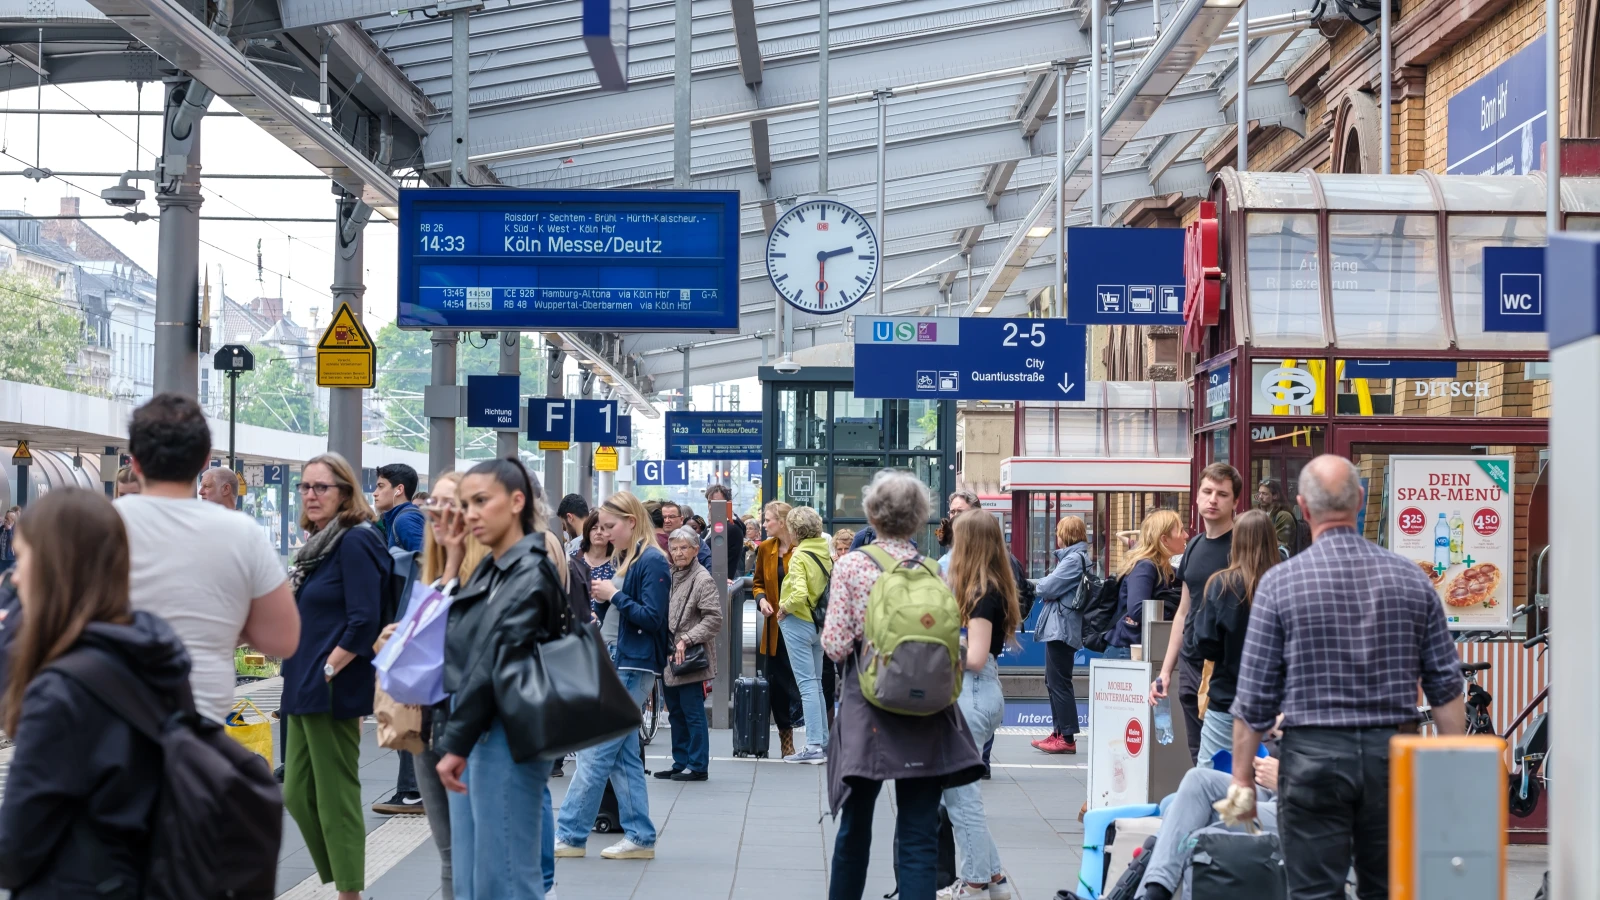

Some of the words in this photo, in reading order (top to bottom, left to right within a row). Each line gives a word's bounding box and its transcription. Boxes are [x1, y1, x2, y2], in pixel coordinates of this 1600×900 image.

[1481, 96, 1496, 131] Bonn
[1498, 79, 1508, 121] Hbf
[504, 213, 539, 222] Roisdorf
[549, 213, 586, 222] Sechtem
[595, 213, 617, 222] Brühl
[627, 214, 700, 223] Hürth-Kalscheur.
[420, 223, 431, 232] RB
[433, 223, 444, 232] 26
[504, 224, 511, 233] K
[513, 224, 529, 233] Süd
[538, 225, 545, 233] K
[547, 225, 570, 233] West
[580, 224, 598, 233] Köln
[601, 225, 616, 233] Hbf
[817, 222, 828, 230] DB
[420, 235, 465, 252] 14:33
[504, 235, 541, 252] Köln
[548, 236, 662, 253] Messe/Deutz
[1300, 259, 1358, 274] Auang
[442, 289, 464, 298] 13:45
[504, 289, 517, 298] ICE
[519, 289, 535, 298] 928
[542, 289, 611, 300] Hamburg-Altona
[618, 290, 631, 298] via
[633, 290, 653, 299] Köln
[655, 290, 670, 299] Hbf
[701, 291, 718, 299] G-A
[1503, 293, 1532, 310] WC
[442, 299, 464, 309] 14:54
[468, 301, 491, 309] 14:59
[504, 300, 515, 309] RB
[517, 300, 527, 309] 48
[534, 300, 633, 311] Wuppertal-Oberbarmen
[640, 301, 653, 310] via
[655, 301, 675, 310] Köln
[677, 301, 692, 310] Hbf
[876, 323, 890, 341] U
[898, 323, 912, 341] S
[1002, 322, 1046, 347] 2-5
[1025, 358, 1045, 370] City
[971, 371, 1045, 382] Quantiusstraße
[1414, 381, 1490, 397] DITSCH
[484, 408, 512, 417] Richtung
[546, 402, 565, 432] F
[599, 403, 612, 433] 1
[672, 426, 689, 434] 14:33
[701, 426, 716, 434] Köln
[271, 466, 281, 481] 2
[644, 462, 658, 481] G
[677, 461, 686, 480] 1
[1428, 473, 1471, 487] DEIN
[1397, 484, 1502, 502] SPAR-MENÜ
[1108, 681, 1132, 692] MOBILER
